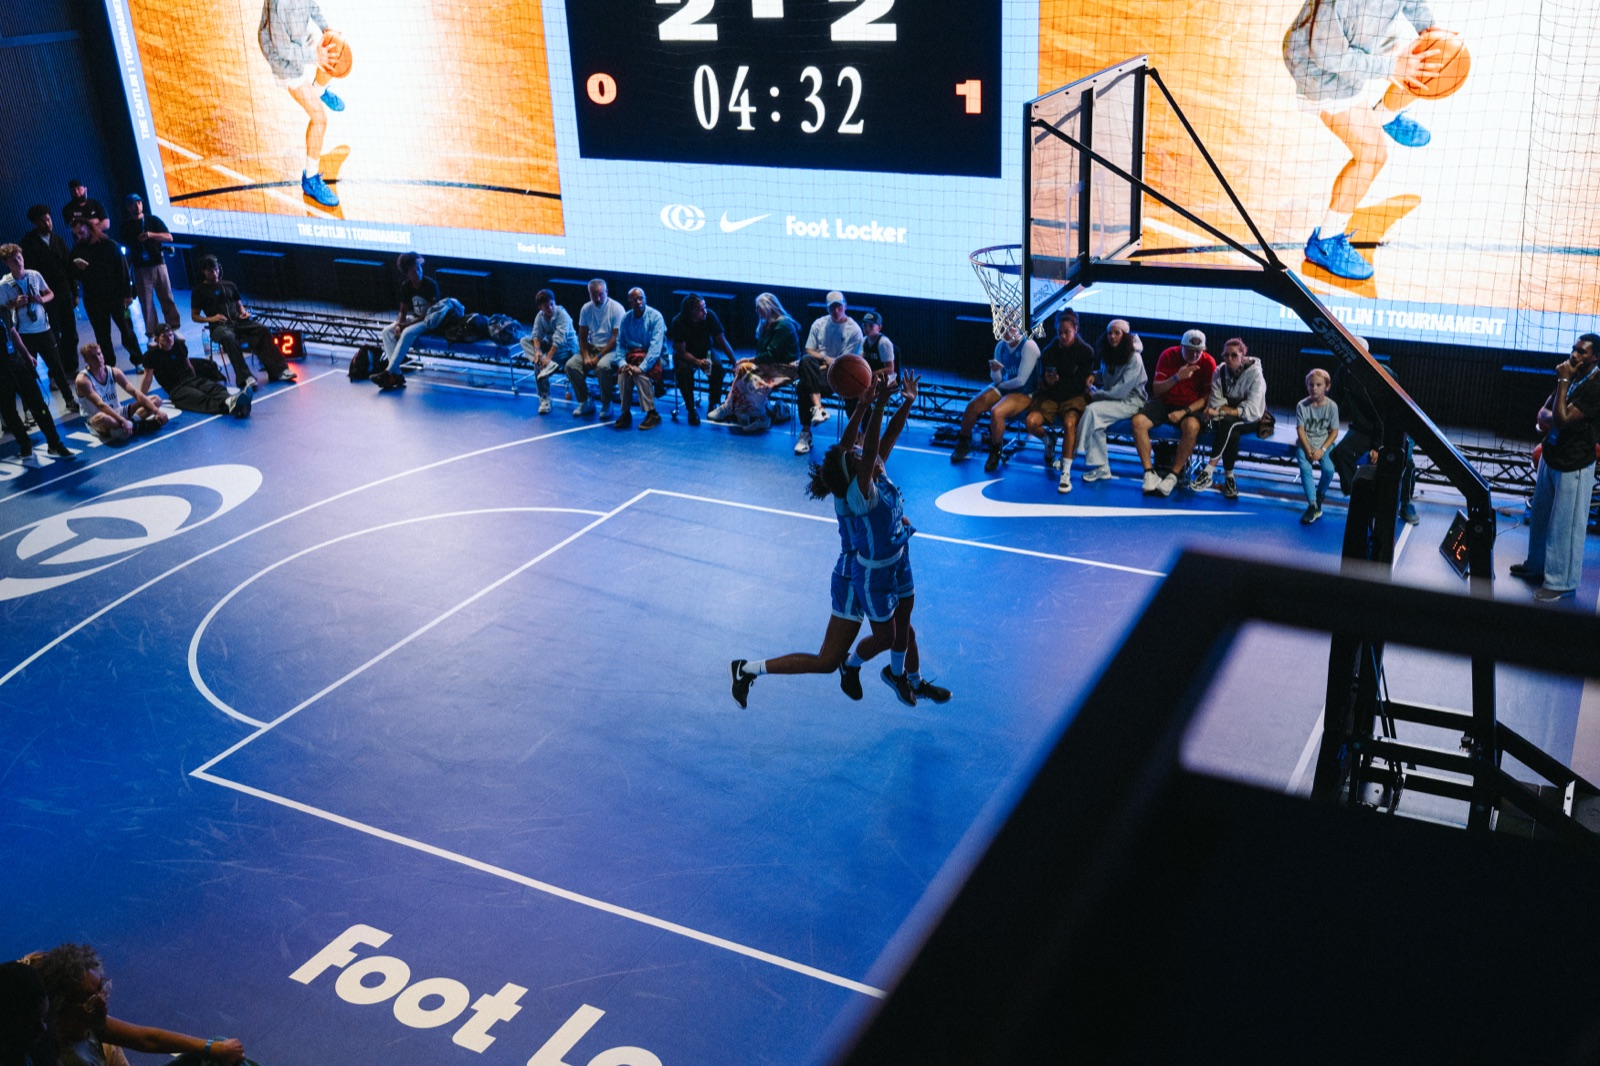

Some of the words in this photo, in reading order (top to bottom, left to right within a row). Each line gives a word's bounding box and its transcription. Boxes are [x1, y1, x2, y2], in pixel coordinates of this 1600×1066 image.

[112, 0, 134, 66] TOURNAME
[586, 73, 617, 105] 0
[693, 65, 864, 134] 04:32
[955, 79, 982, 114] 1
[297, 223, 314, 237] THE
[313, 224, 346, 239] CAITLIN
[351, 228, 411, 245] TOURNAMENT
[785, 215, 831, 238] Foot
[835, 217, 908, 244] Locker
[1325, 304, 1374, 326] ITLIN
[1377, 309, 1385, 327] 1
[1386, 311, 1506, 336] TOURNAMENT
[288, 923, 529, 1054] Foot
